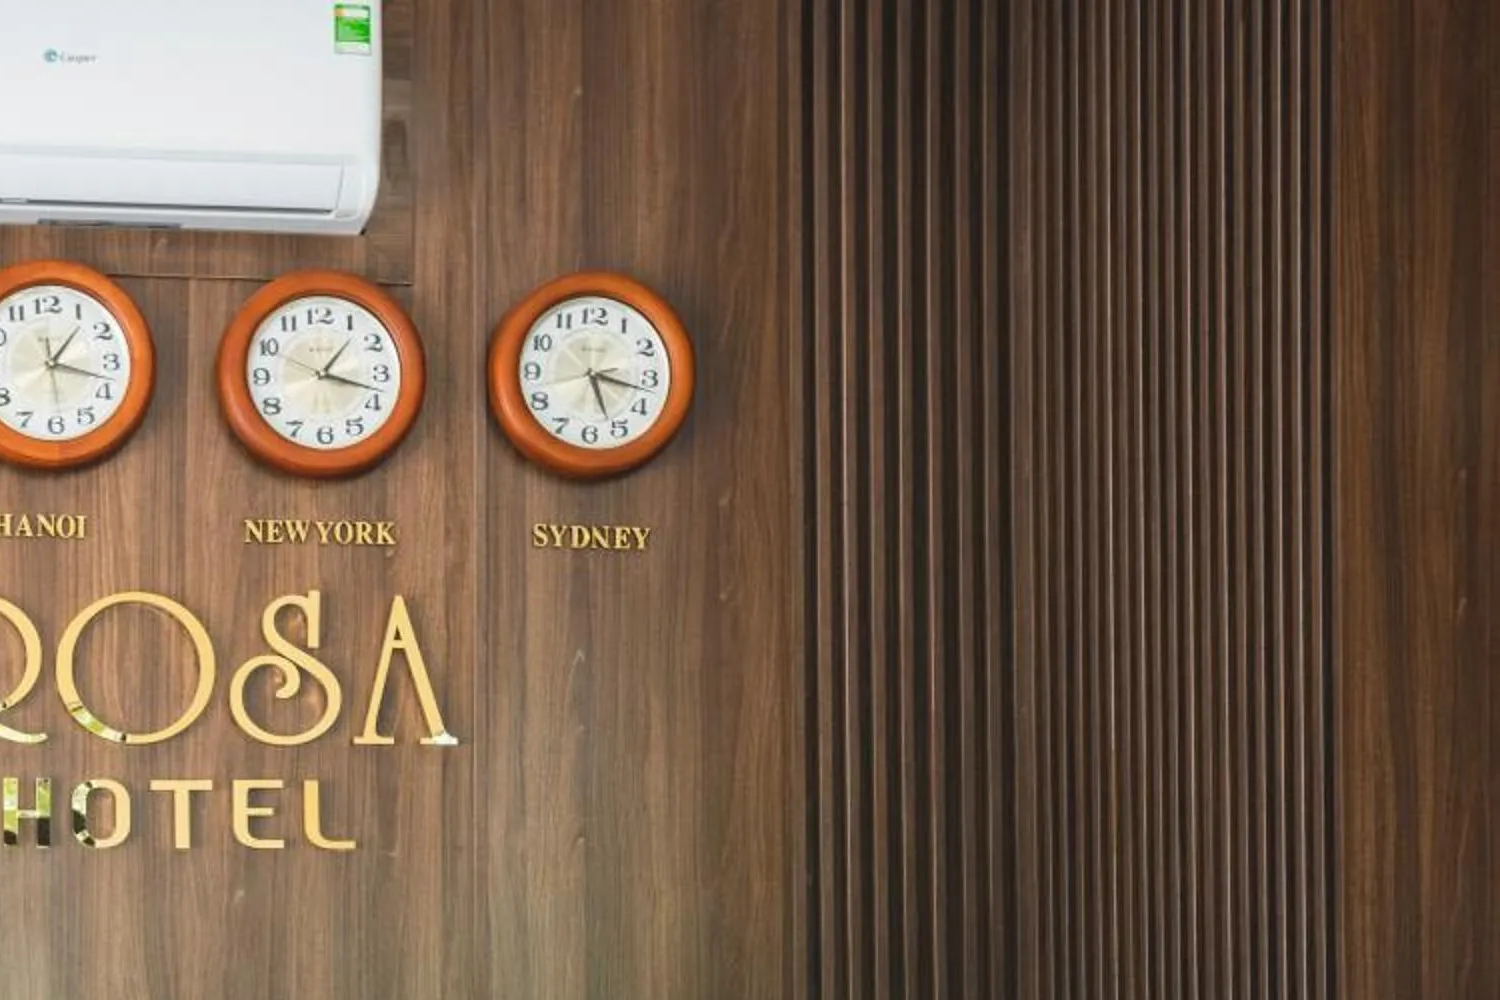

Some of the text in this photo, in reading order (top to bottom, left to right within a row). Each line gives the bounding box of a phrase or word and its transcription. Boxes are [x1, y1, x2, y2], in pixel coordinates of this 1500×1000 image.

[9, 305, 24, 321] 11
[35, 296, 62, 314] 12
[75, 304, 82, 320] 1
[281, 316, 297, 331] 11
[307, 308, 334, 324] 12
[346, 315, 354, 330] 1
[557, 314, 572, 329] 11
[582, 308, 608, 325] 12
[93, 323, 113, 340] 2
[621, 318, 627, 333] 1
[260, 338, 279, 356] 10
[364, 334, 383, 352] 2
[533, 334, 553, 351] 10
[637, 339, 655, 357] 2
[103, 354, 120, 370] 3
[253, 368, 270, 384] 9
[373, 365, 390, 382] 3
[524, 362, 541, 380] 9
[642, 370, 658, 387] 3
[95, 384, 112, 400] 4
[263, 398, 282, 415] 8
[365, 394, 381, 411] 4
[532, 392, 548, 410] 8
[631, 399, 647, 416] 4
[17, 412, 33, 428] 7
[77, 407, 95, 425] 5
[48, 416, 64, 434] 6
[287, 420, 303, 437] 7
[346, 417, 364, 435] 5
[553, 418, 569, 434] 7
[611, 420, 628, 437] 5
[317, 427, 334, 444] 6
[582, 426, 598, 444] 6
[532, 523, 651, 549] SYDNEY
[2, 777, 357, 850] HOTEL
